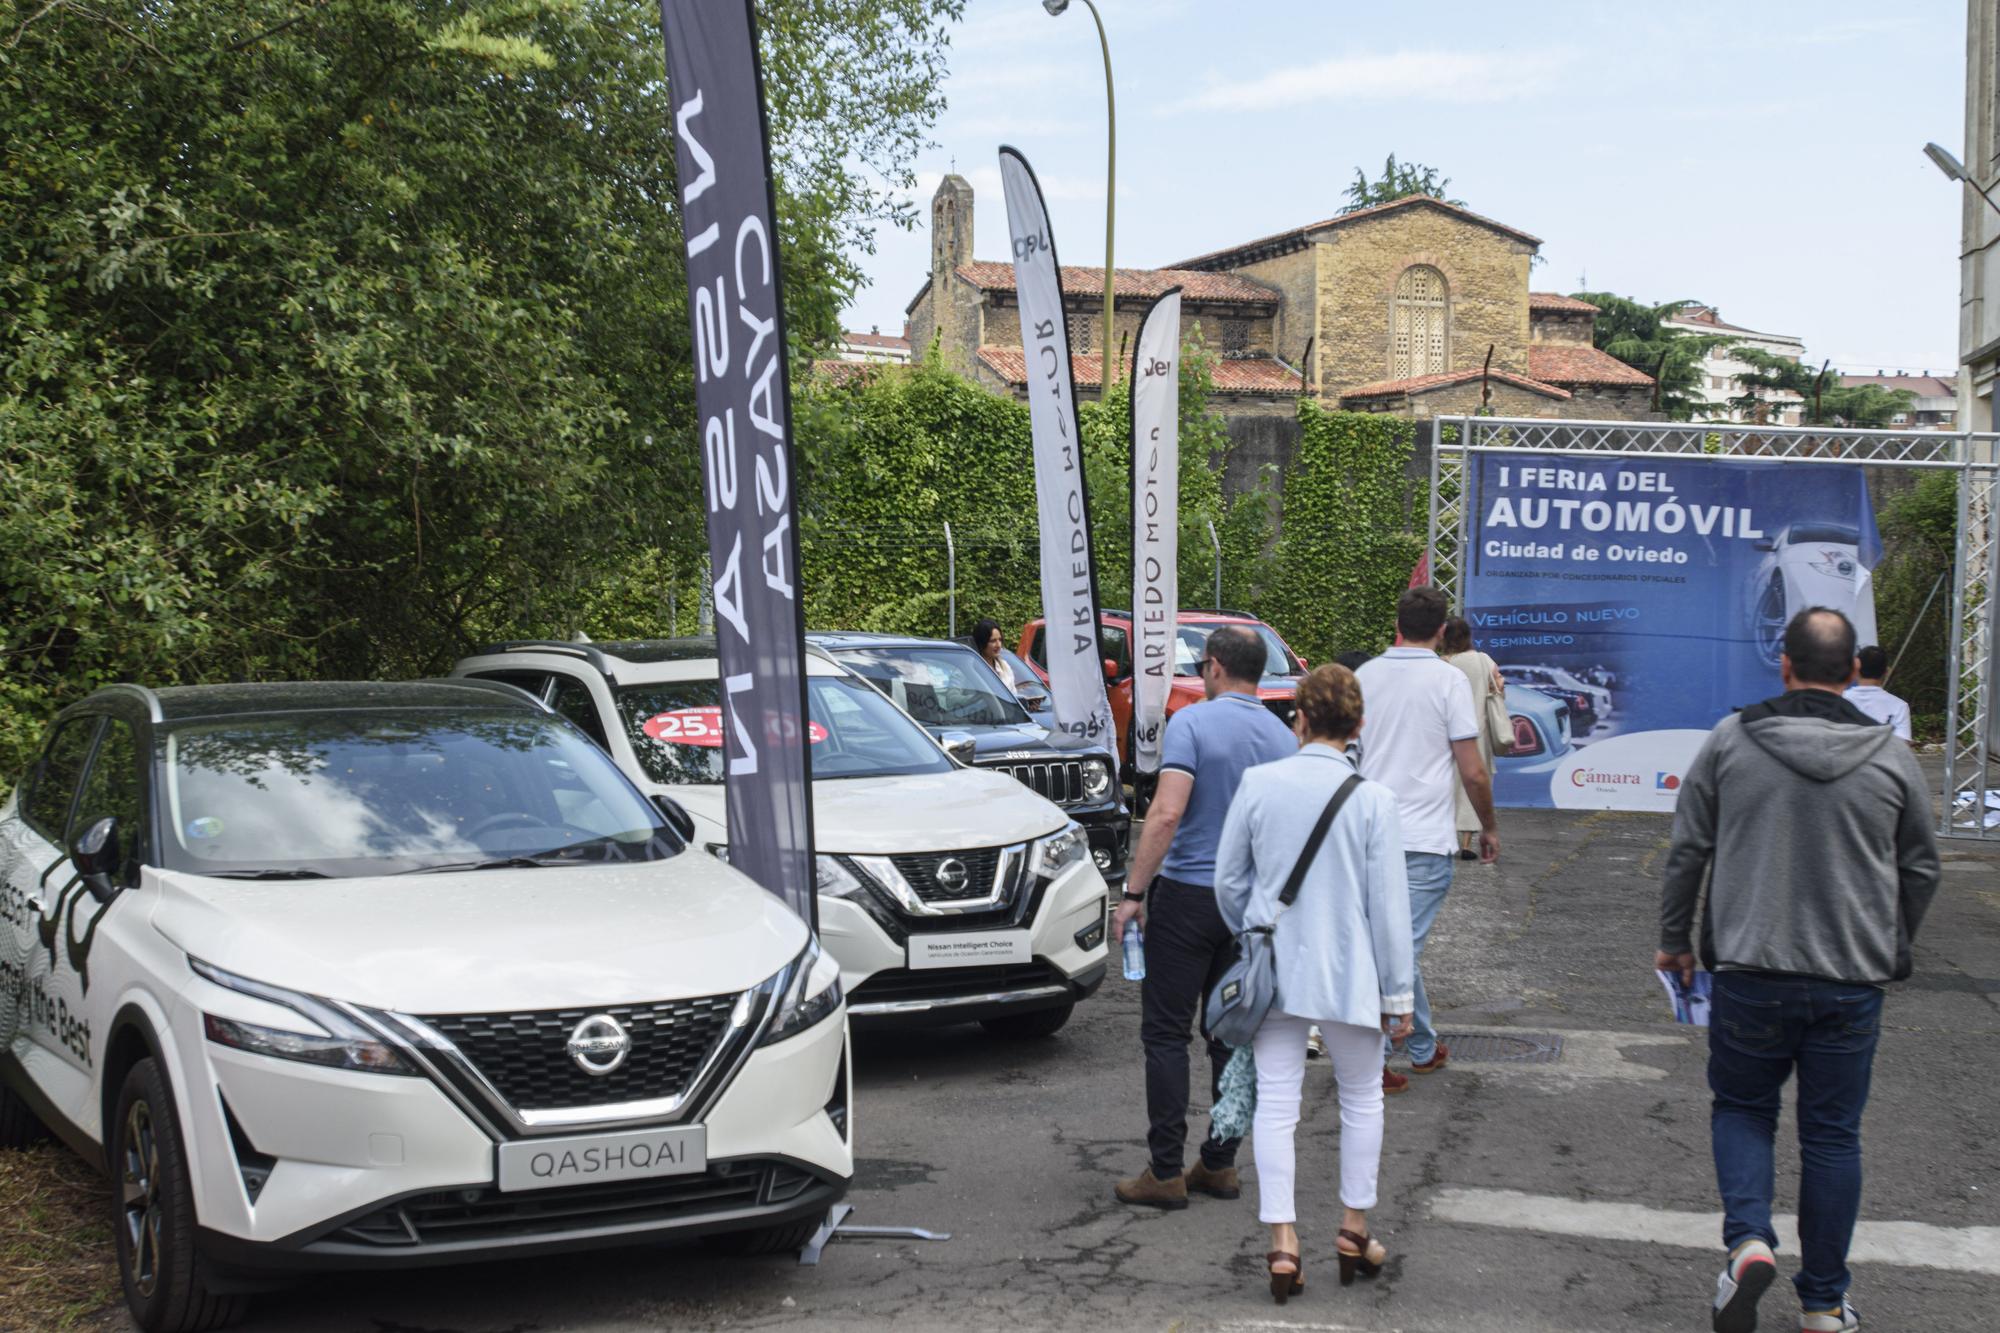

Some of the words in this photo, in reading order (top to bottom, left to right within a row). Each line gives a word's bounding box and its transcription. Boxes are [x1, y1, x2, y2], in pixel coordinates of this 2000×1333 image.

[1499, 467, 1509, 487] I
[1520, 468, 1607, 491] FERIA
[1617, 471, 1674, 492] DEL
[1486, 496, 1764, 539] AUTOMÓVIL
[1484, 540, 1563, 559] Ciudad
[1571, 544, 1599, 561] de
[1607, 544, 1688, 564] Oviedo
[1542, 571, 1560, 579] POR
[1562, 573, 1638, 582] CONCESIONARIOS
[1641, 575, 1686, 583] OFICIALES
[1144, 556, 1166, 677] ARTEDO
[1472, 609, 1568, 626] VEHÍCULO
[1576, 607, 1640, 623] NUEVO
[1490, 634, 1574, 648] SEMINUEVO
[1572, 768, 1641, 787] Cámara
[927, 943, 952, 951] Nissan
[953, 941, 989, 951] Intelligent
[990, 940, 1013, 948] Choice
[58, 997, 93, 1068] Best
[575, 1040, 625, 1051] NISSAN
[530, 1140, 684, 1178] QASHQAI
